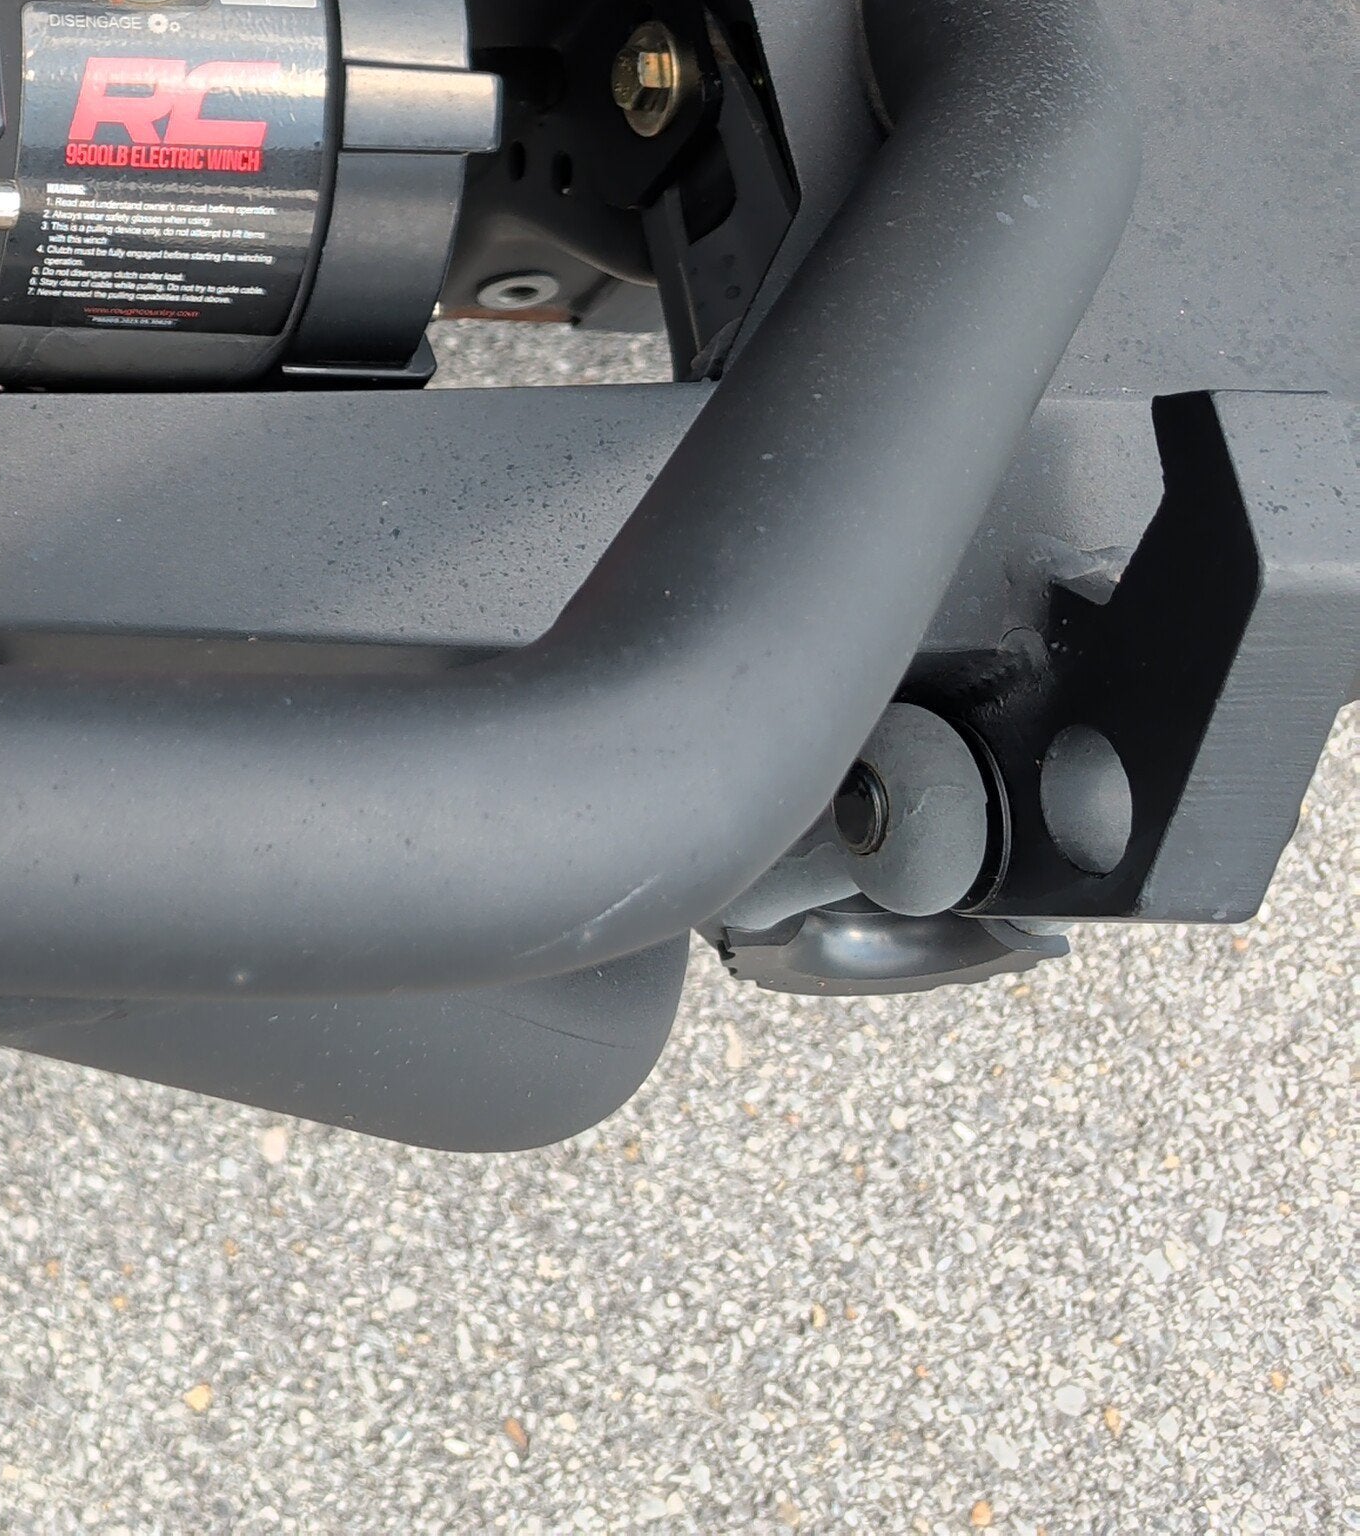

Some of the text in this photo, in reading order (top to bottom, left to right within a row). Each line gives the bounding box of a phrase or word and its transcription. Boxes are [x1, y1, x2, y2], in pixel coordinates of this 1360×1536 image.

[49, 13, 142, 30] DISENGAGE
[67, 56, 282, 148] RC
[66, 143, 261, 172] 9500LB ELECTRIC WINCH
[54, 197, 78, 208] Read
[78, 199, 95, 208] and
[51, 210, 82, 221] Always
[51, 221, 68, 232] This
[70, 223, 78, 232] is
[46, 244, 73, 255] Clutch
[41, 266, 55, 276] Do
[55, 268, 69, 277] not
[39, 277, 59, 288] Stay
[59, 278, 80, 288] clear
[166, 282, 179, 291] Do
[36, 287, 61, 297] Never
